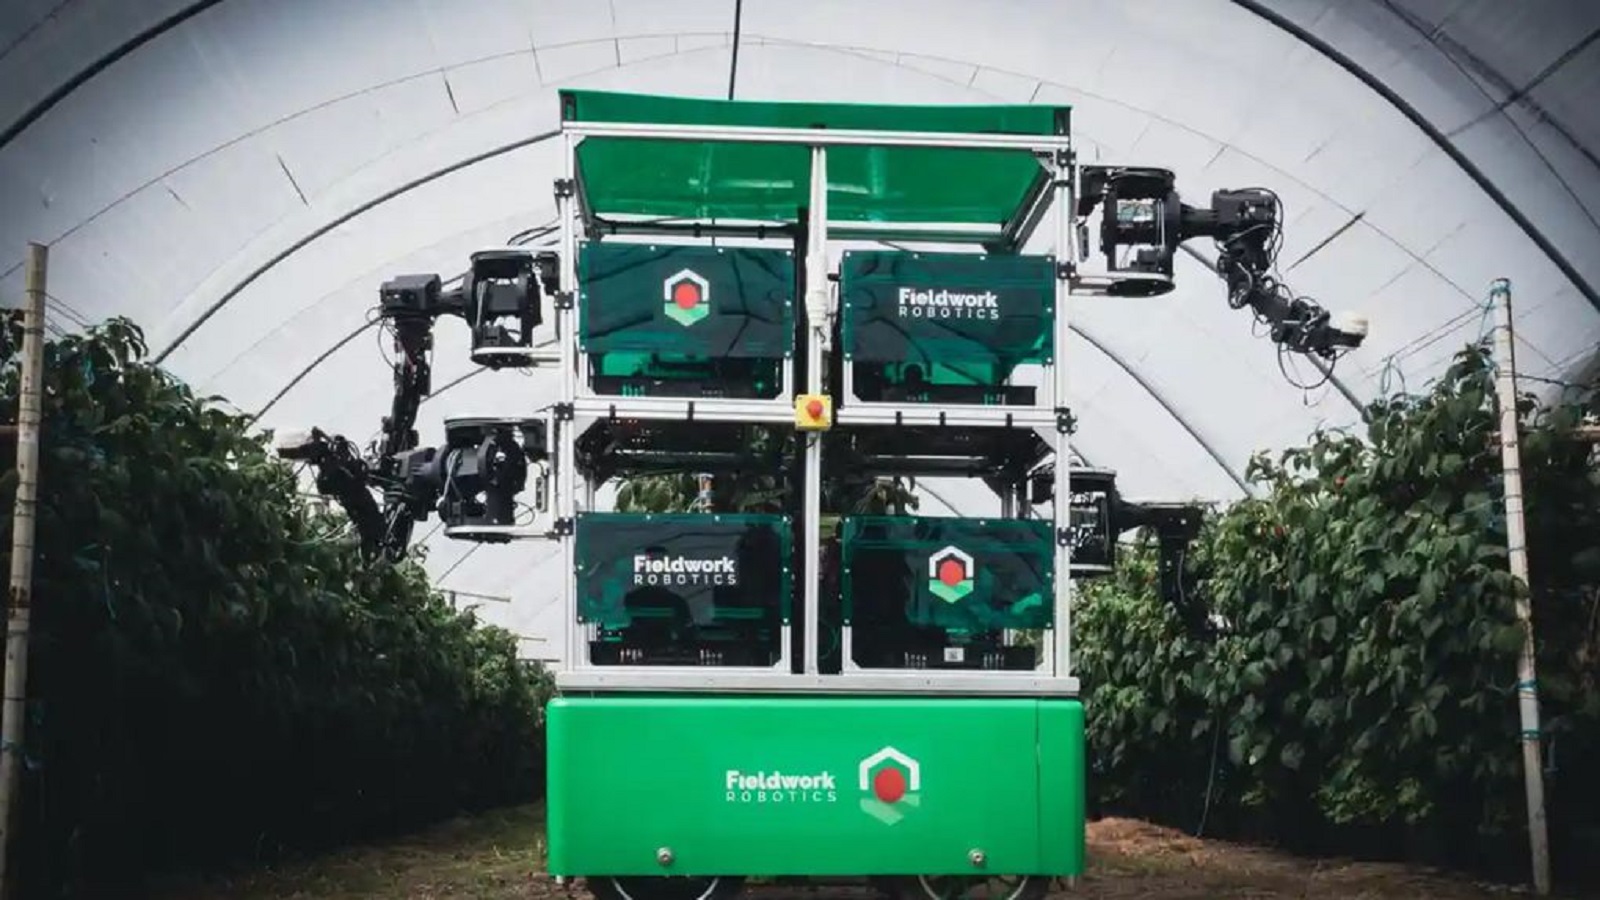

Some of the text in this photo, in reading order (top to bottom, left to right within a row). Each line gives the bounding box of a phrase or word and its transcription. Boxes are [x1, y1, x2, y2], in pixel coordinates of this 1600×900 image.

[899, 287, 998, 308] Fieldwork
[899, 306, 999, 319] ROBOTICS
[634, 554, 735, 573] Fieldwork
[634, 573, 737, 585] ROBOTICS
[726, 770, 836, 790] Fieldwork
[726, 791, 837, 802] ROBOTICS
